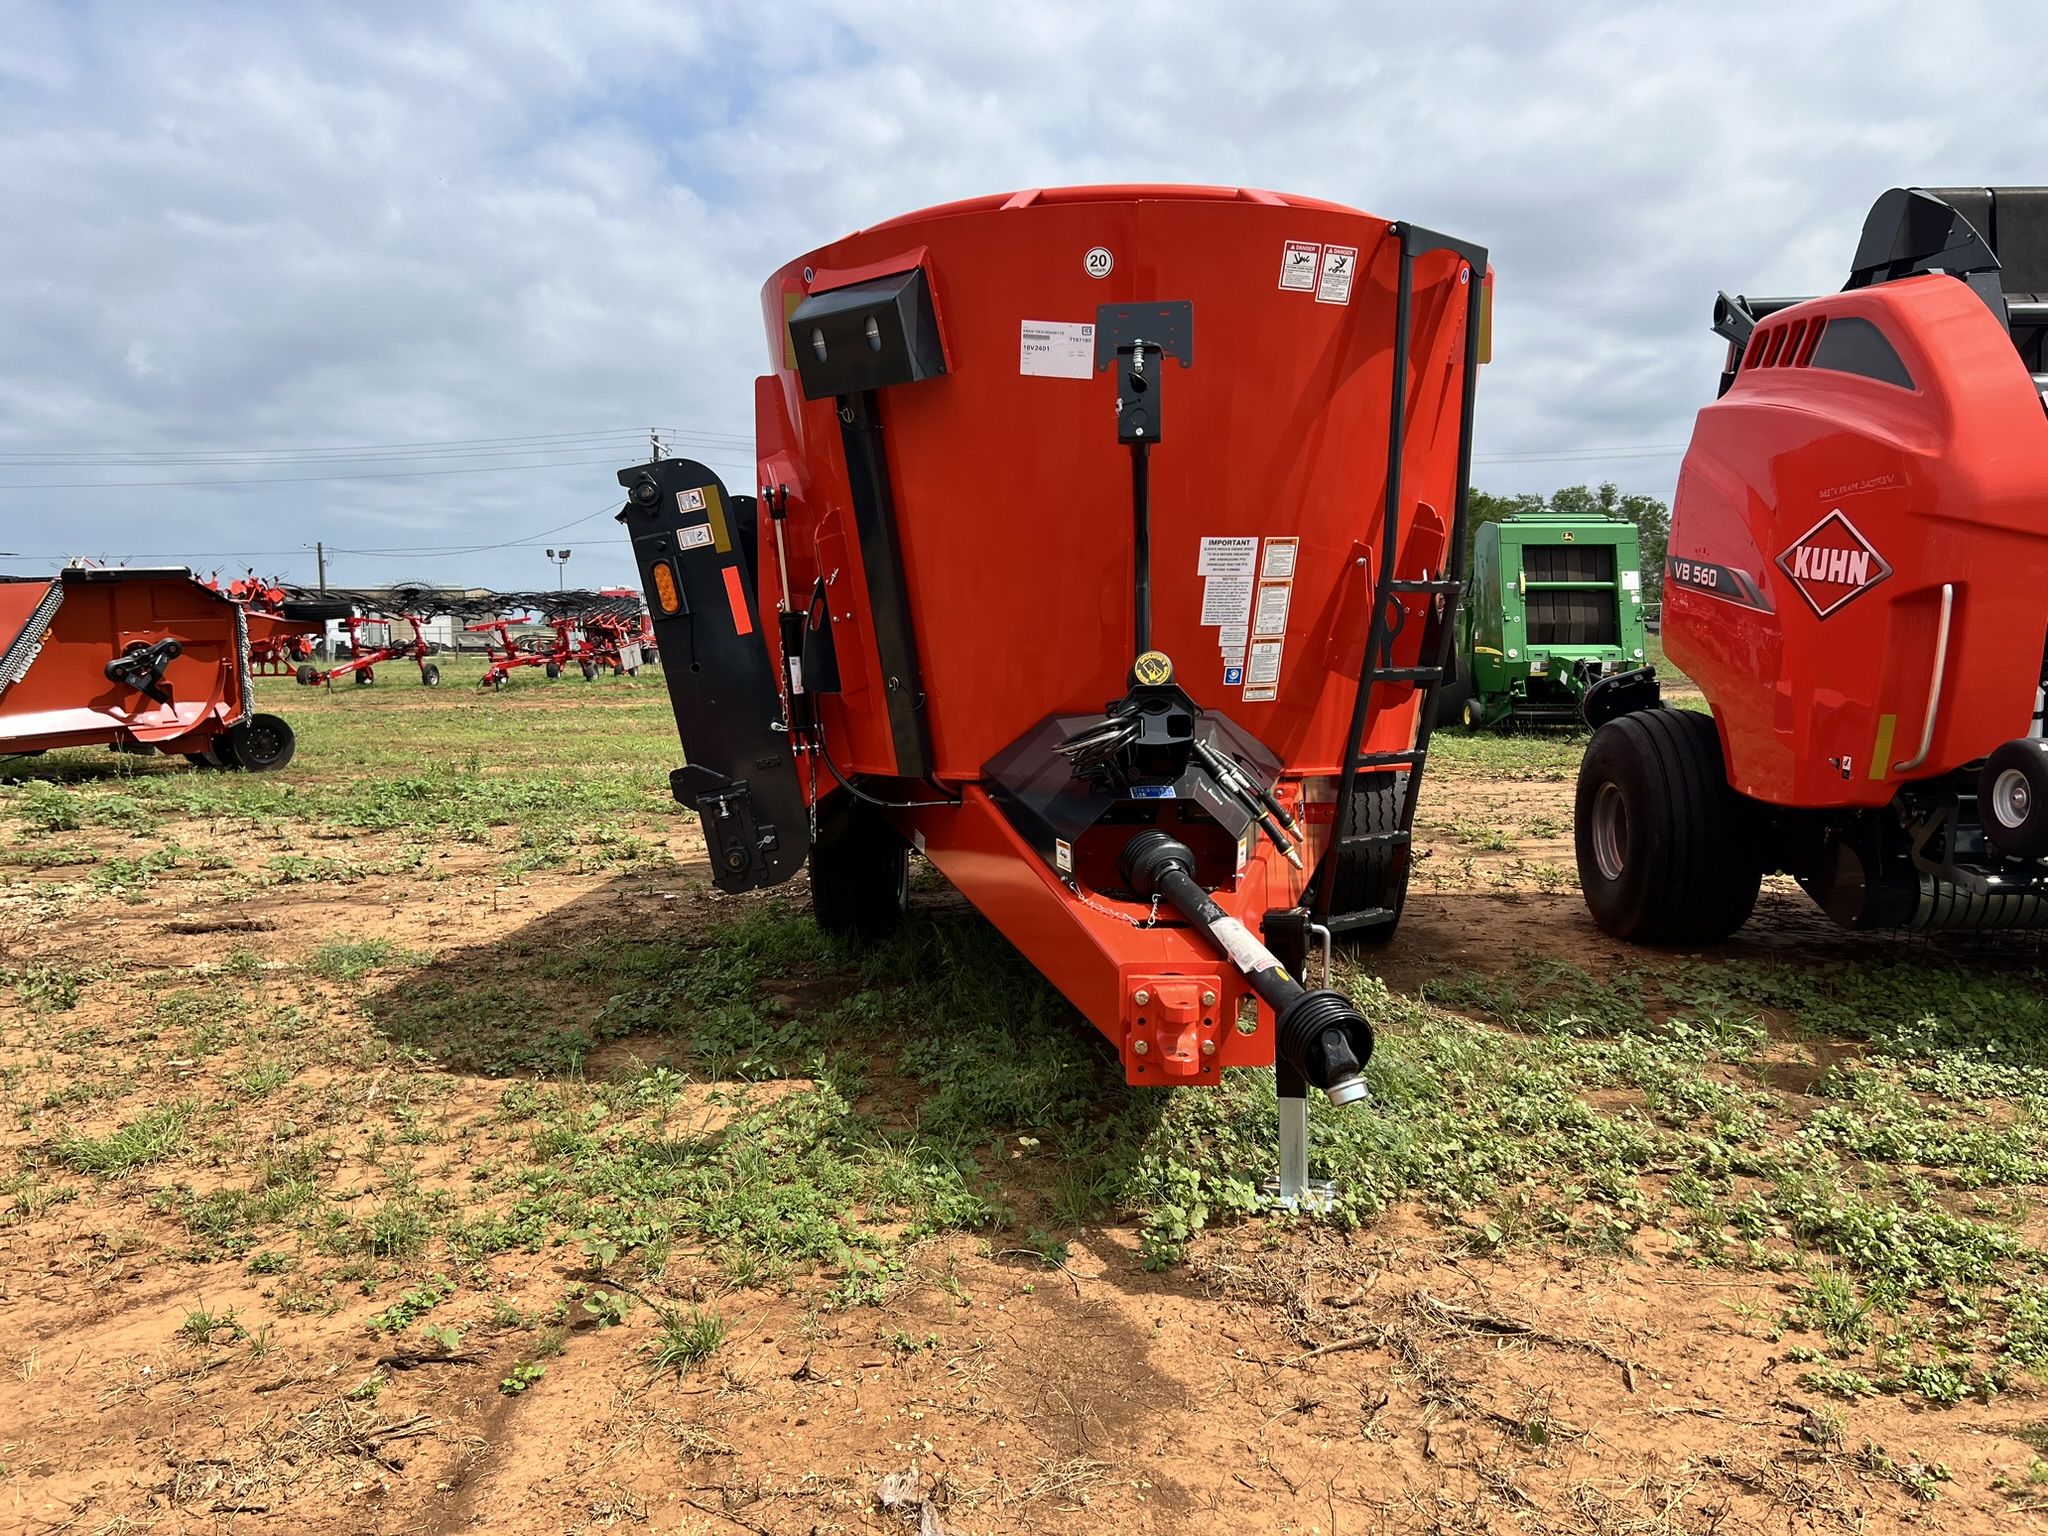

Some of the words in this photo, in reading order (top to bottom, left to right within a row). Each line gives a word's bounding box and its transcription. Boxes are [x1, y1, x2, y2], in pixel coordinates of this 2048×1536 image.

[1090, 254, 1107, 267] 20
[1333, 248, 1353, 256] DANGER
[1675, 562, 1689, 581] VB
[1693, 565, 1718, 588] 560
[1794, 546, 1870, 586] KUHN
